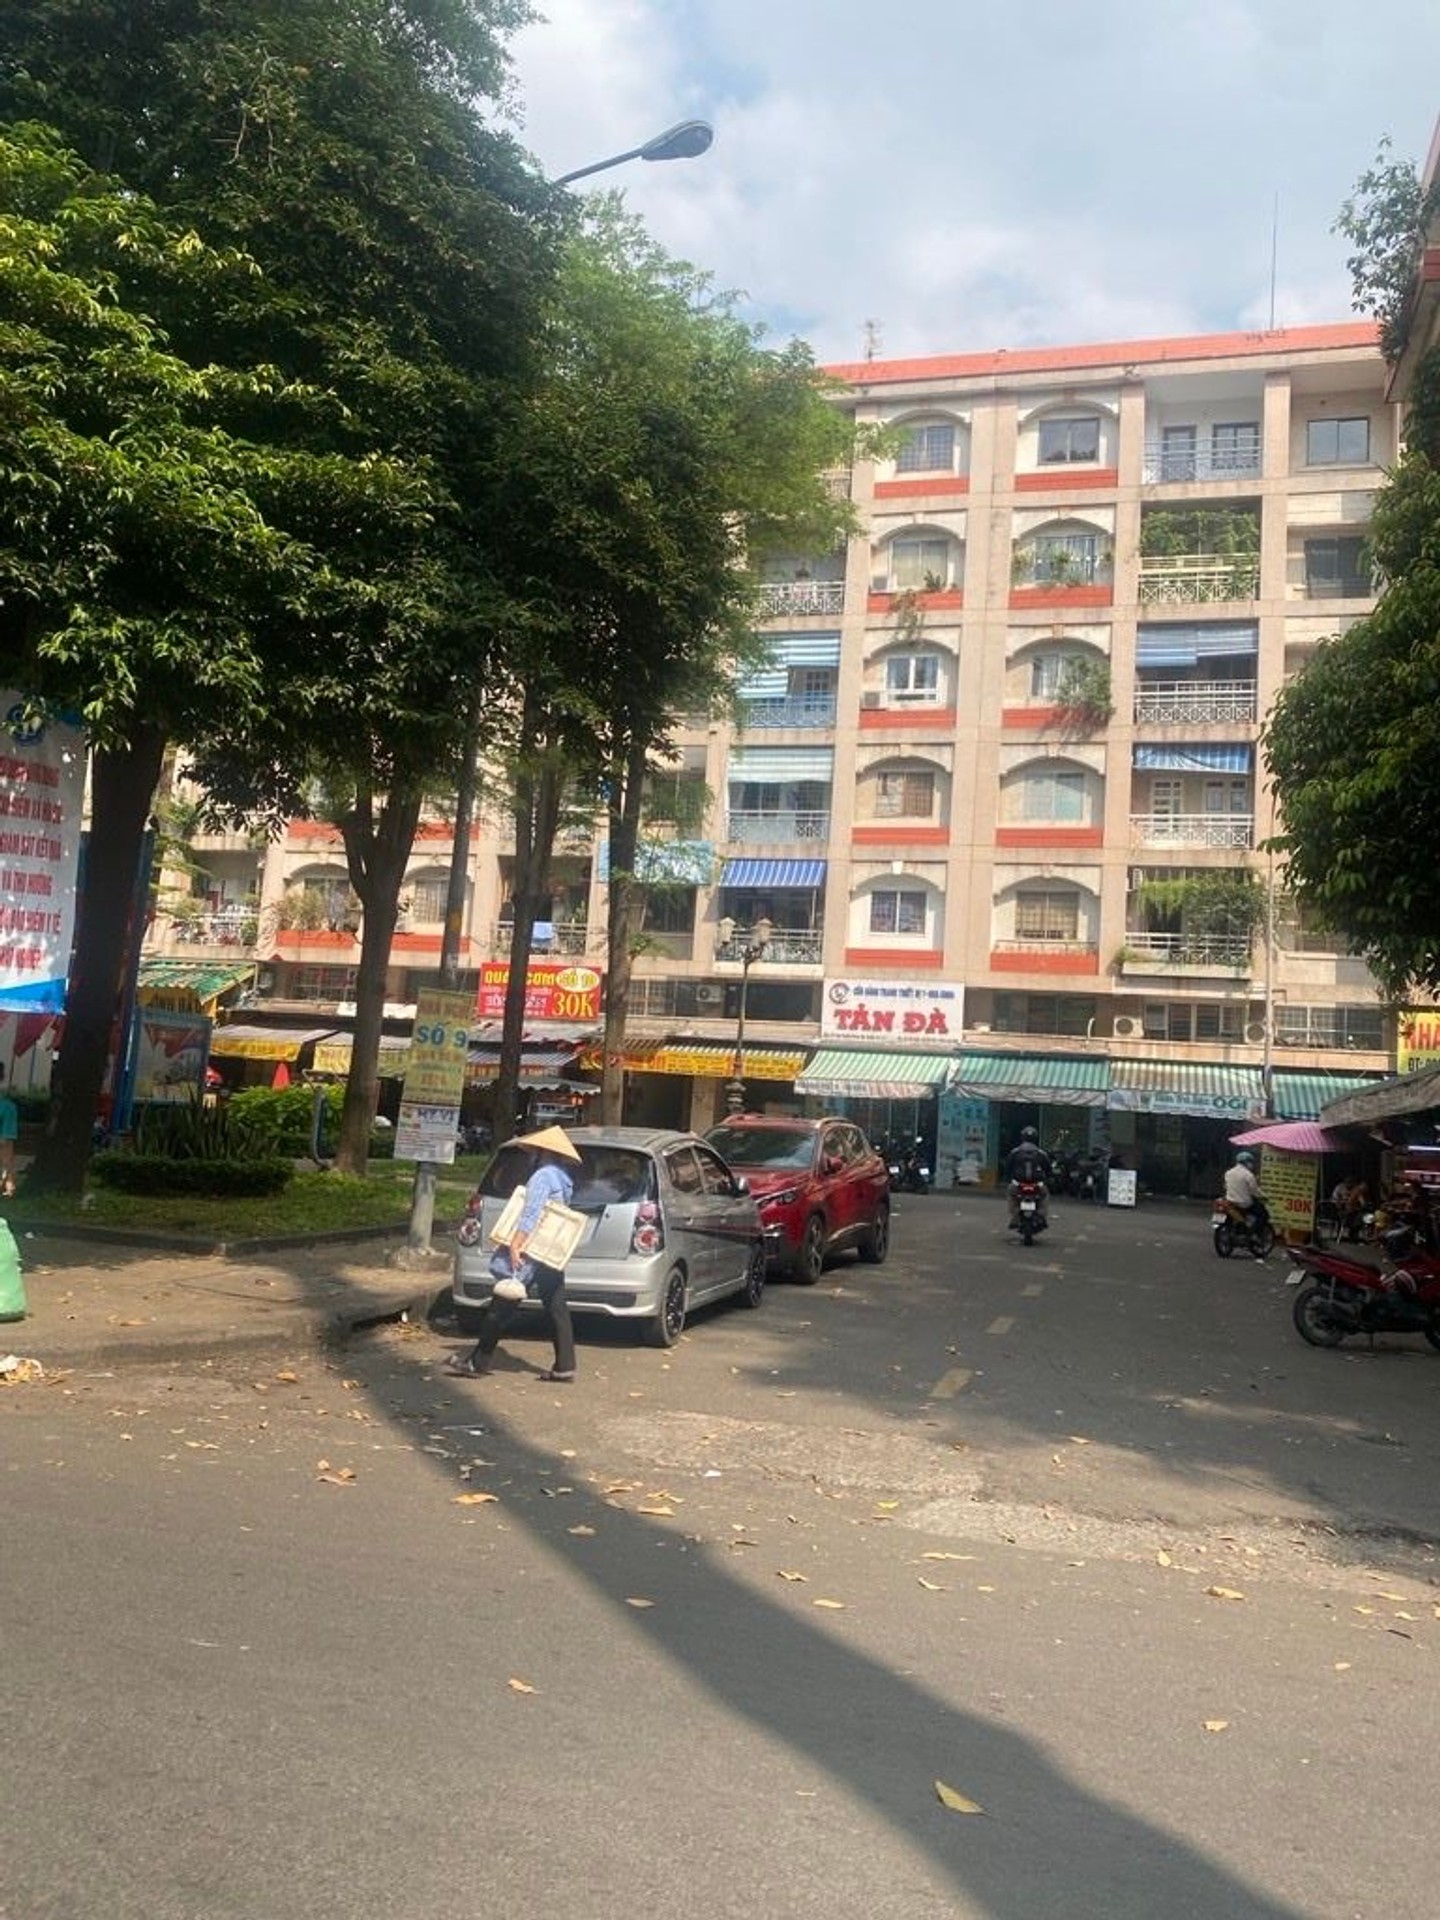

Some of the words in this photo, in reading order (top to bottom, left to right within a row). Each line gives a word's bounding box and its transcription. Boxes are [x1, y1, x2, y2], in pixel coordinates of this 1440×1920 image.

[551, 992, 594, 1018] 30K
[833, 1003, 895, 1032] TẢN
[902, 1006, 948, 1034] ĐÀ
[417, 1021, 446, 1046] SỐ
[453, 1030, 467, 1048] 9
[1284, 1199, 1312, 1213] 30K
